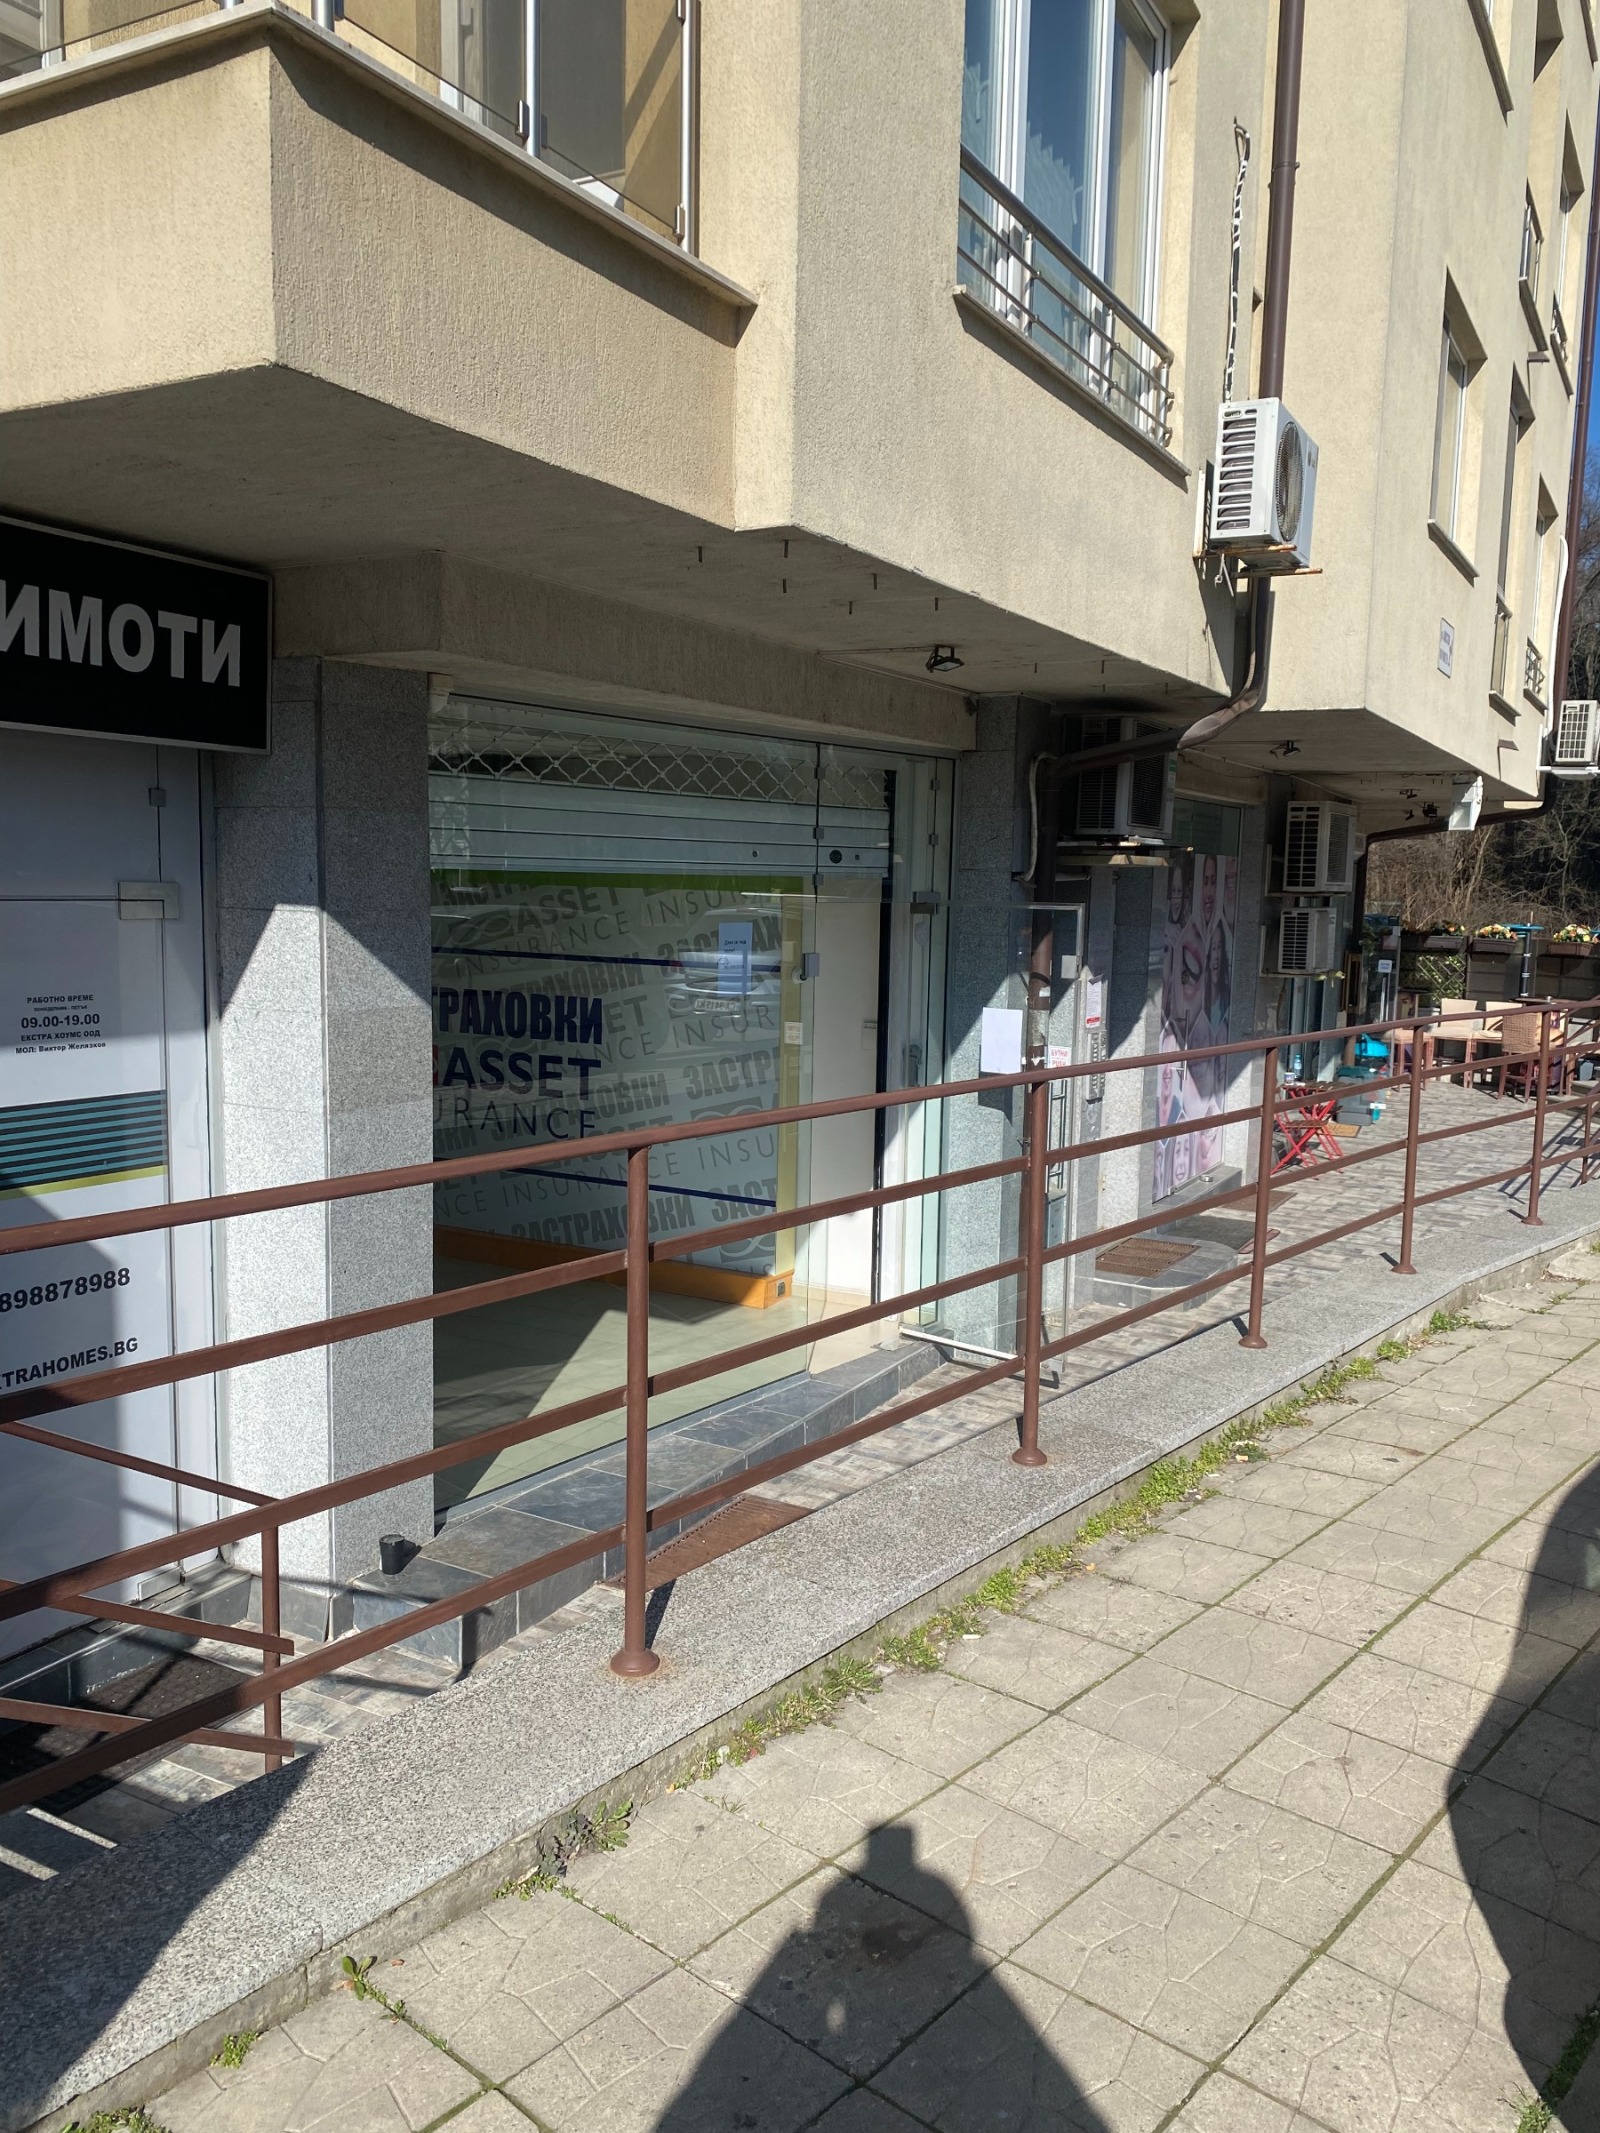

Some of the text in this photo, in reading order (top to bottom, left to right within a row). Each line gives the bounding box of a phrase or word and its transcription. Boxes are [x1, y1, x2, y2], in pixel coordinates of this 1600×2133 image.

[0, 578, 241, 688] ИМОТИ
[27, 994, 94, 1004] РАБОТНО ВРЕМЕ
[21, 1013, 100, 1029] 09.00-19.00
[21, 1029, 101, 1041] ЕКСТРА ХОУМС ООД
[15, 1042, 106, 1054] МОЛ: Виктор Желязков
[442, 1046, 602, 1101] ASSET
[0, 1267, 131, 1313] 898878988
[0, 1337, 138, 1390] TRAHOMES.BG
